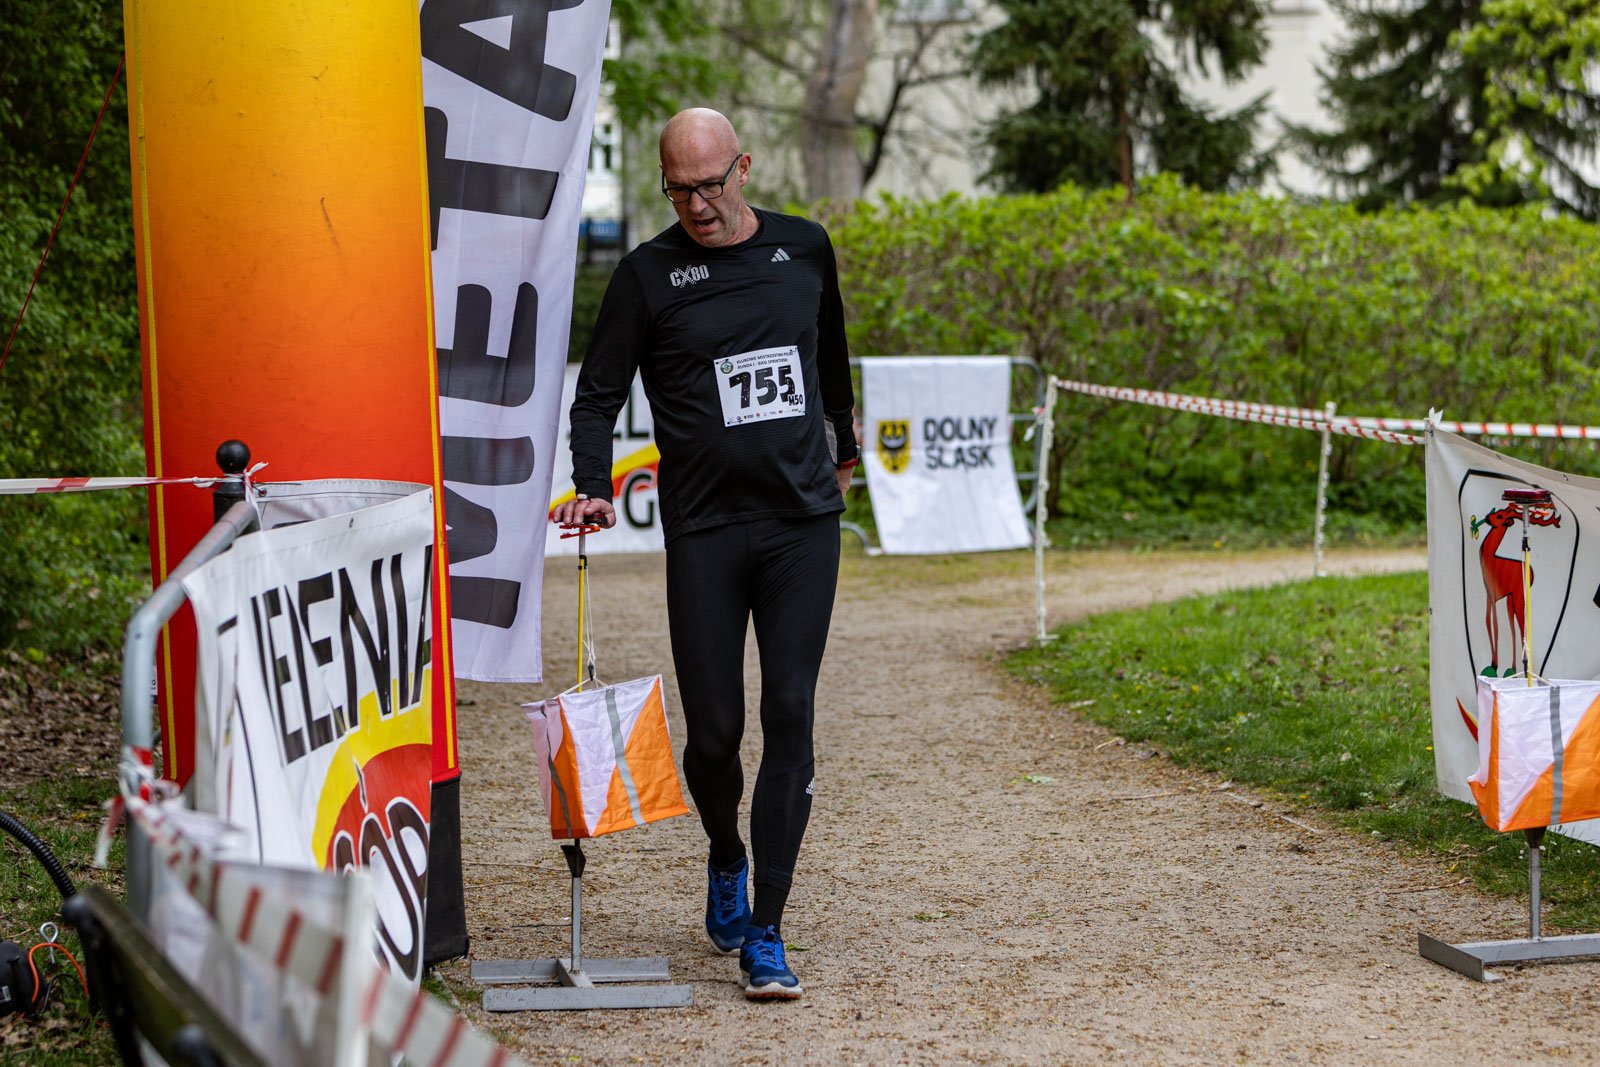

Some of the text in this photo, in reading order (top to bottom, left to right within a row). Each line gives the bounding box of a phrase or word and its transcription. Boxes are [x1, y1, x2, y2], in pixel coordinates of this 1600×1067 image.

[669, 264, 710, 288] CX80
[729, 365, 796, 409] 755
[788, 394, 804, 406] M50
[923, 416, 997, 441] DOLNY
